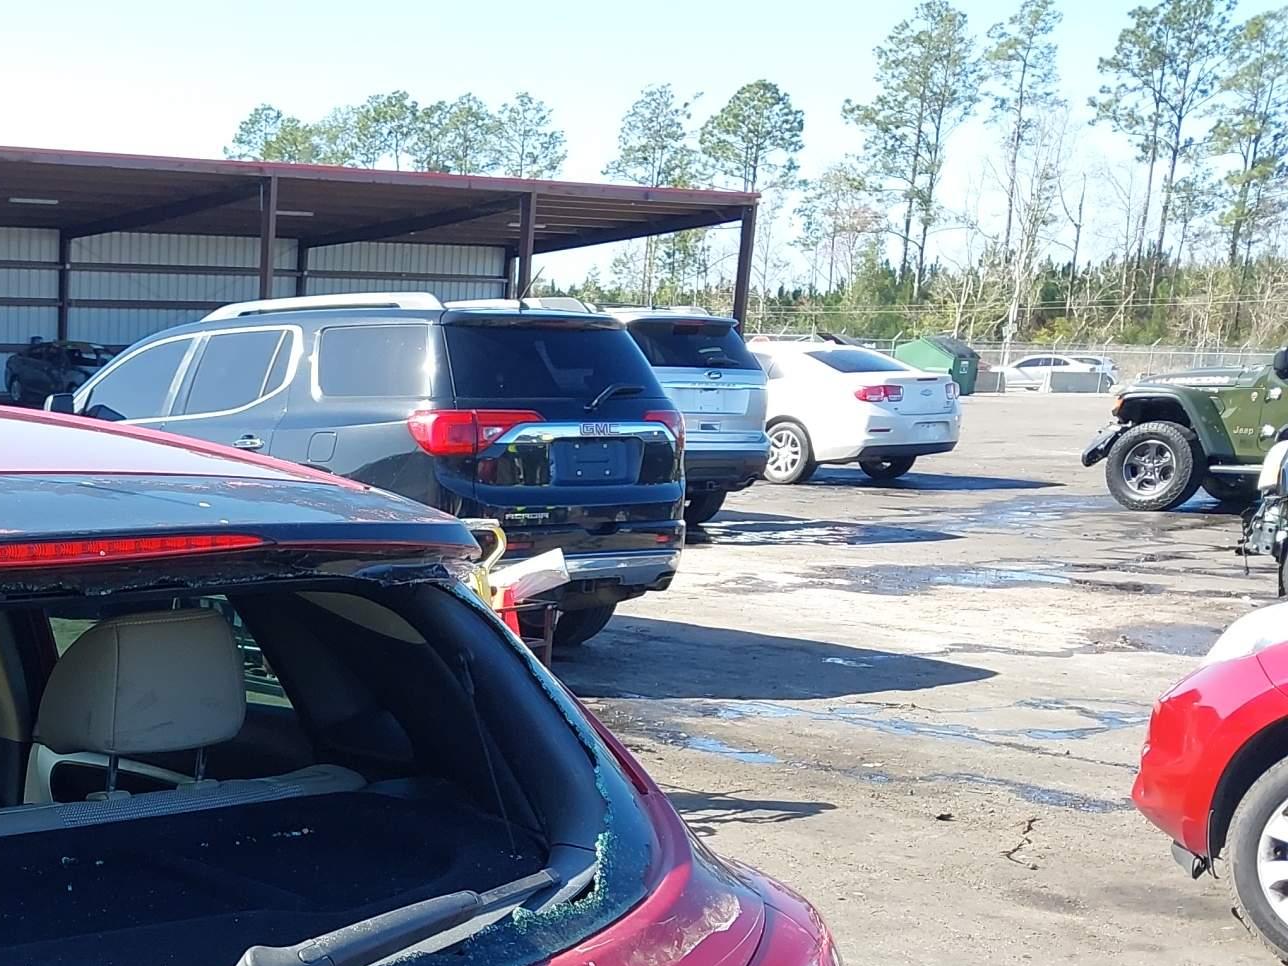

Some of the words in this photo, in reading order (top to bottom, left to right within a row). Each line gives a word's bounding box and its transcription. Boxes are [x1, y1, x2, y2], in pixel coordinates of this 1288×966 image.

[579, 423, 620, 436] GMC
[1233, 425, 1254, 436] Jeep
[505, 512, 550, 520] ACADIA
